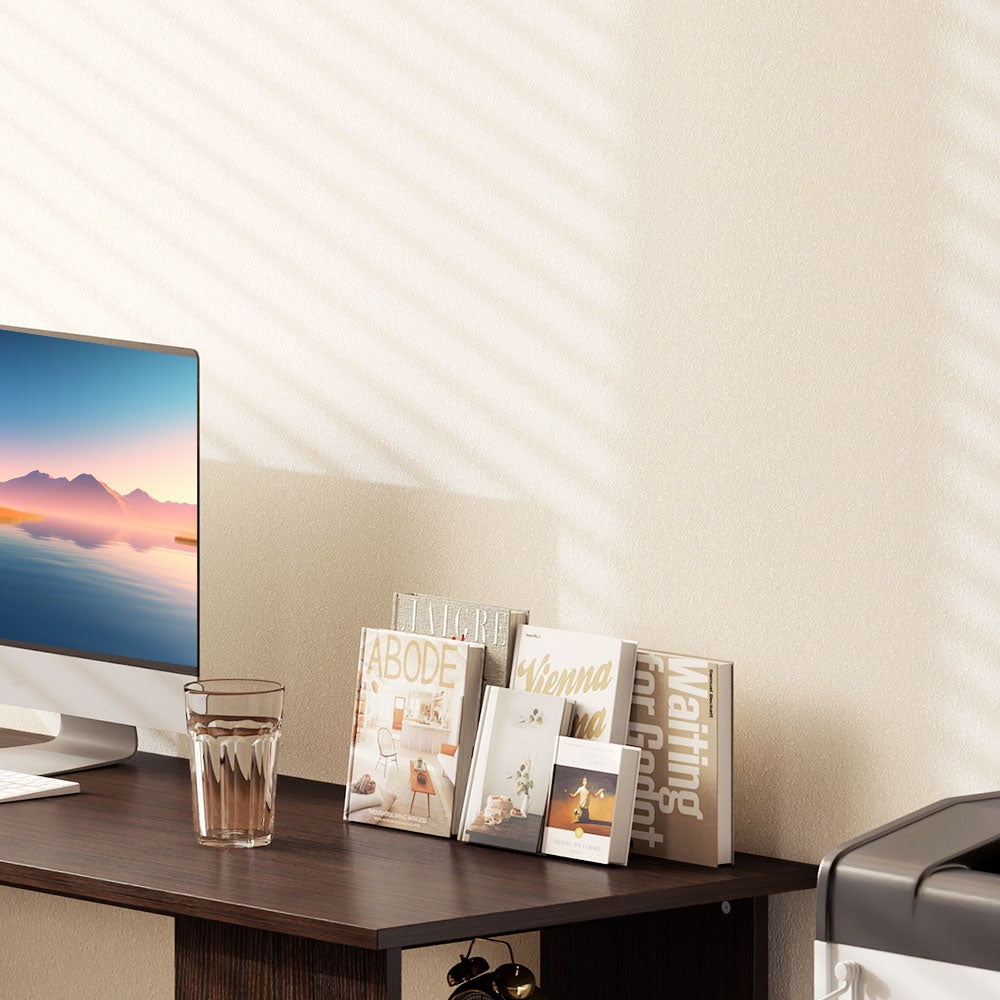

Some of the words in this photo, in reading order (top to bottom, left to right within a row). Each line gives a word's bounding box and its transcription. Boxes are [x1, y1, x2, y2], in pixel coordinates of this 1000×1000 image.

[366, 633, 458, 689] ABODE
[517, 653, 613, 696] Vienna
[631, 653, 664, 716] for
[658, 655, 709, 820] Waiting
[626, 721, 664, 848] Godot
